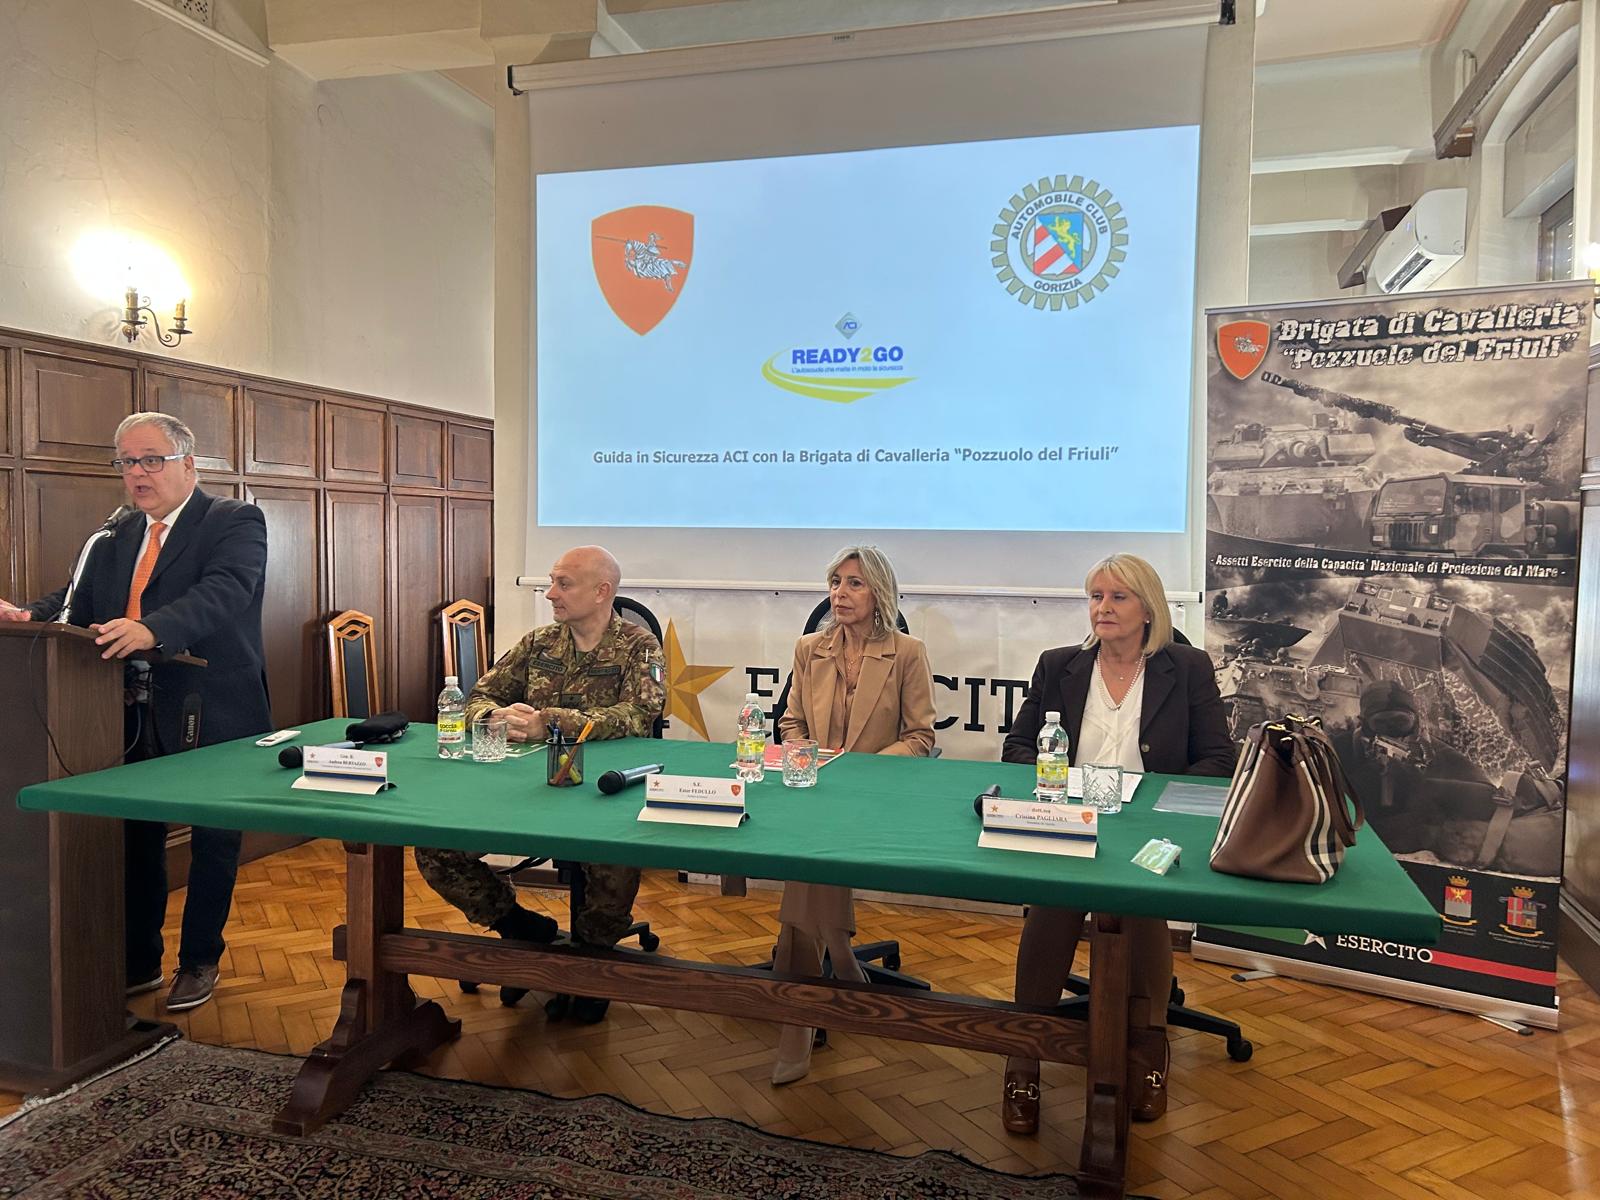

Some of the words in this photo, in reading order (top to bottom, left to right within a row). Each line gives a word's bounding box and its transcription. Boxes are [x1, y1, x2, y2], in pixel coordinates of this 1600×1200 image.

[1011, 193, 1085, 239] AUTOMOBILE
[1085, 203, 1109, 235] CLUB
[1034, 278, 1083, 293] GORIZIA
[1278, 317, 1379, 345] Brigata
[1388, 312, 1416, 335] di
[1423, 303, 1580, 333] Cavalleria
[791, 346, 904, 365] READY2GO
[1422, 339, 1468, 364] del
[593, 451, 632, 464] Guida
[637, 451, 649, 464] in
[652, 450, 719, 464] Sicurezza
[723, 450, 749, 463] ACI
[752, 453, 778, 463] con
[782, 449, 795, 463] la
[799, 450, 852, 465] Brigata
[856, 448, 870, 462] di
[875, 448, 950, 462] Cavalleria
[1038, 446, 1063, 461] del
[1215, 555, 1249, 567] Assetti
[1251, 555, 1292, 569] Esercito
[1294, 556, 1319, 569] della
[1370, 559, 1424, 573] Nazionale
[1427, 562, 1438, 574] di
[1504, 564, 1523, 577] dal
[1525, 565, 1559, 578] Mare
[185, 714, 196, 743] Canon
[1336, 934, 1434, 963] ESERCITO
